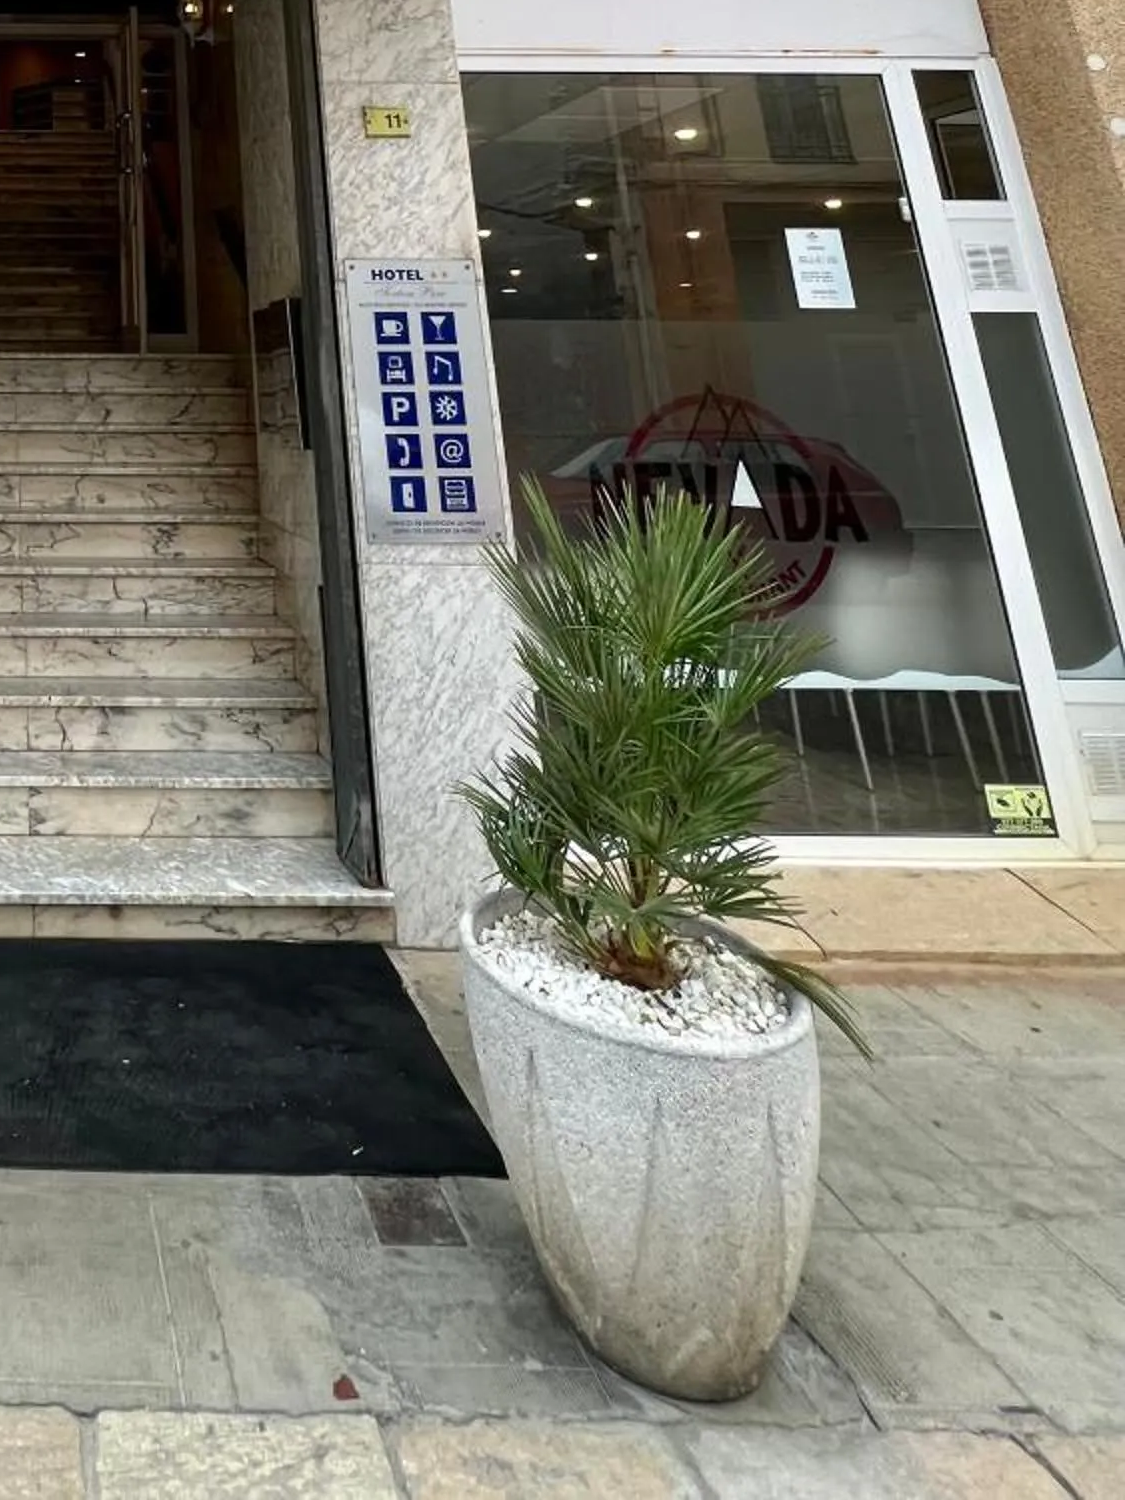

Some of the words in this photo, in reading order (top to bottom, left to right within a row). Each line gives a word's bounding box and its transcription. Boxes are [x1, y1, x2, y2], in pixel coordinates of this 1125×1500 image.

[384, 113, 402, 129] 11
[370, 269, 424, 281] HOTEL
[588, 450, 870, 544] NEVADA
